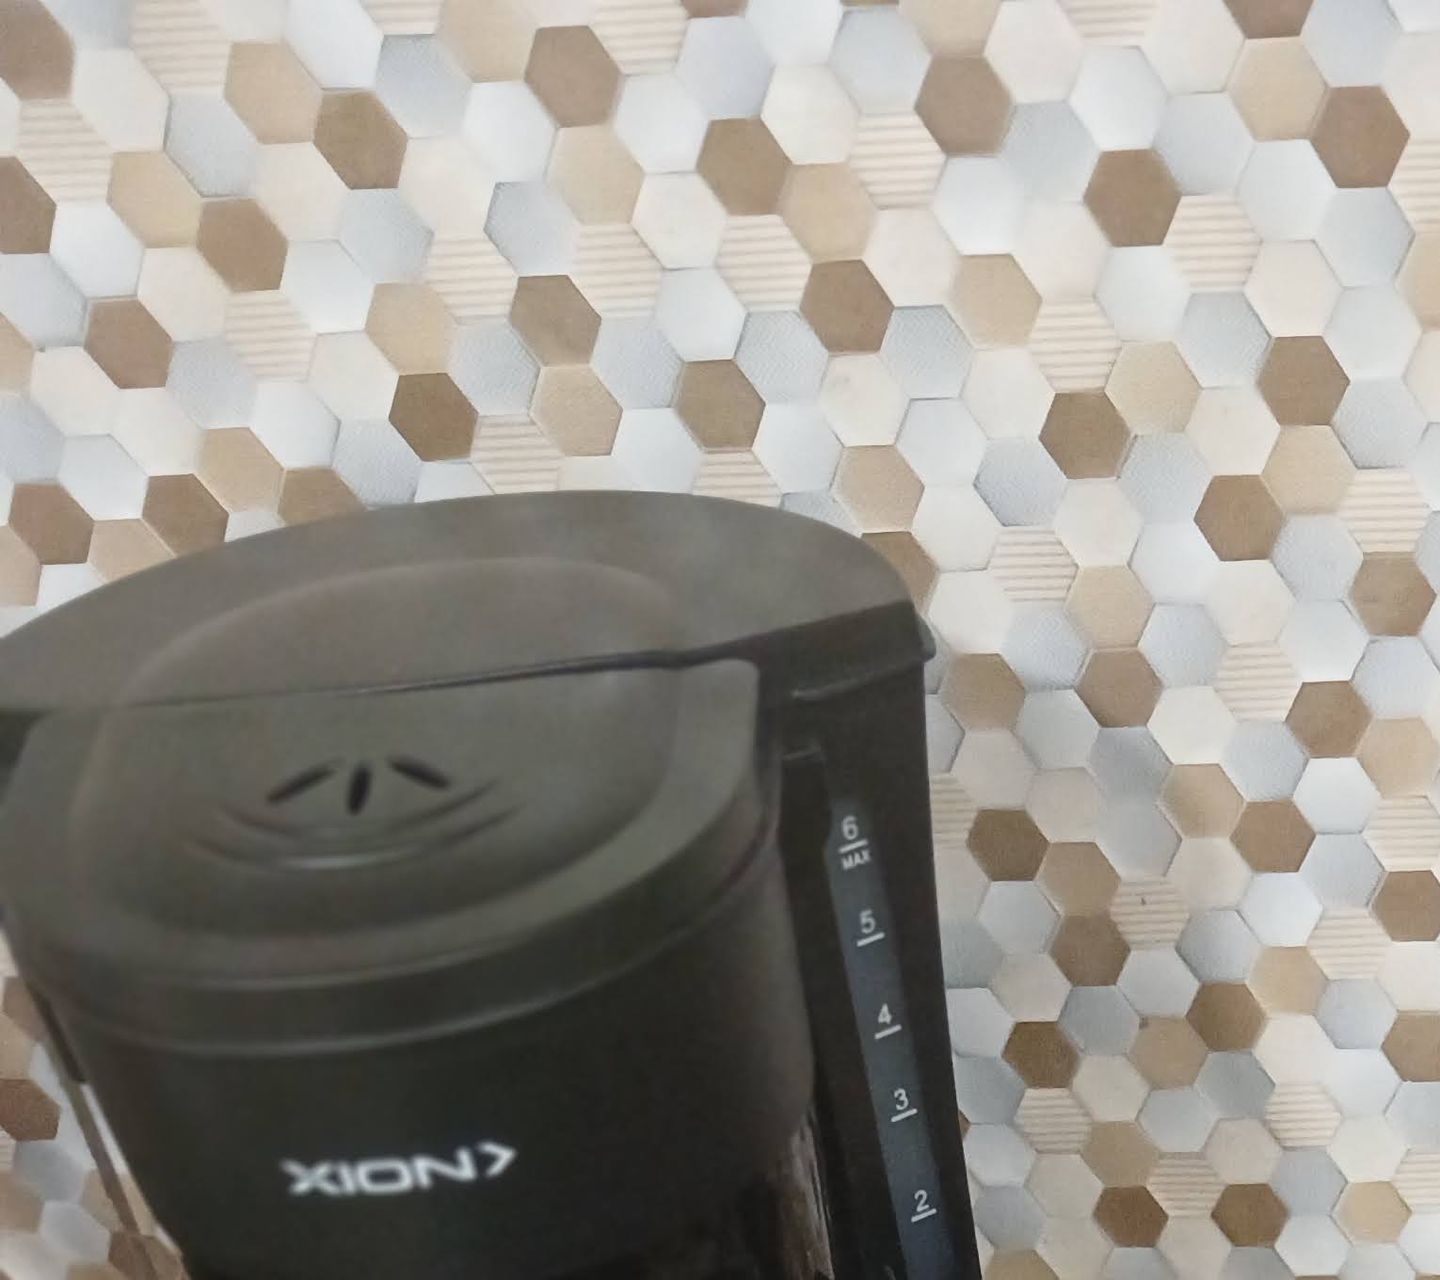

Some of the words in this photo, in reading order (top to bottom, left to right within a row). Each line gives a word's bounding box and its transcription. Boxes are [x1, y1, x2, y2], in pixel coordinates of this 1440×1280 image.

[841, 815, 859, 841] 6
[841, 850, 873, 871] MAX
[859, 910, 876, 935] 5
[877, 1003, 893, 1025] 4
[893, 1088, 910, 1111] 3
[913, 1190, 930, 1212] 2
